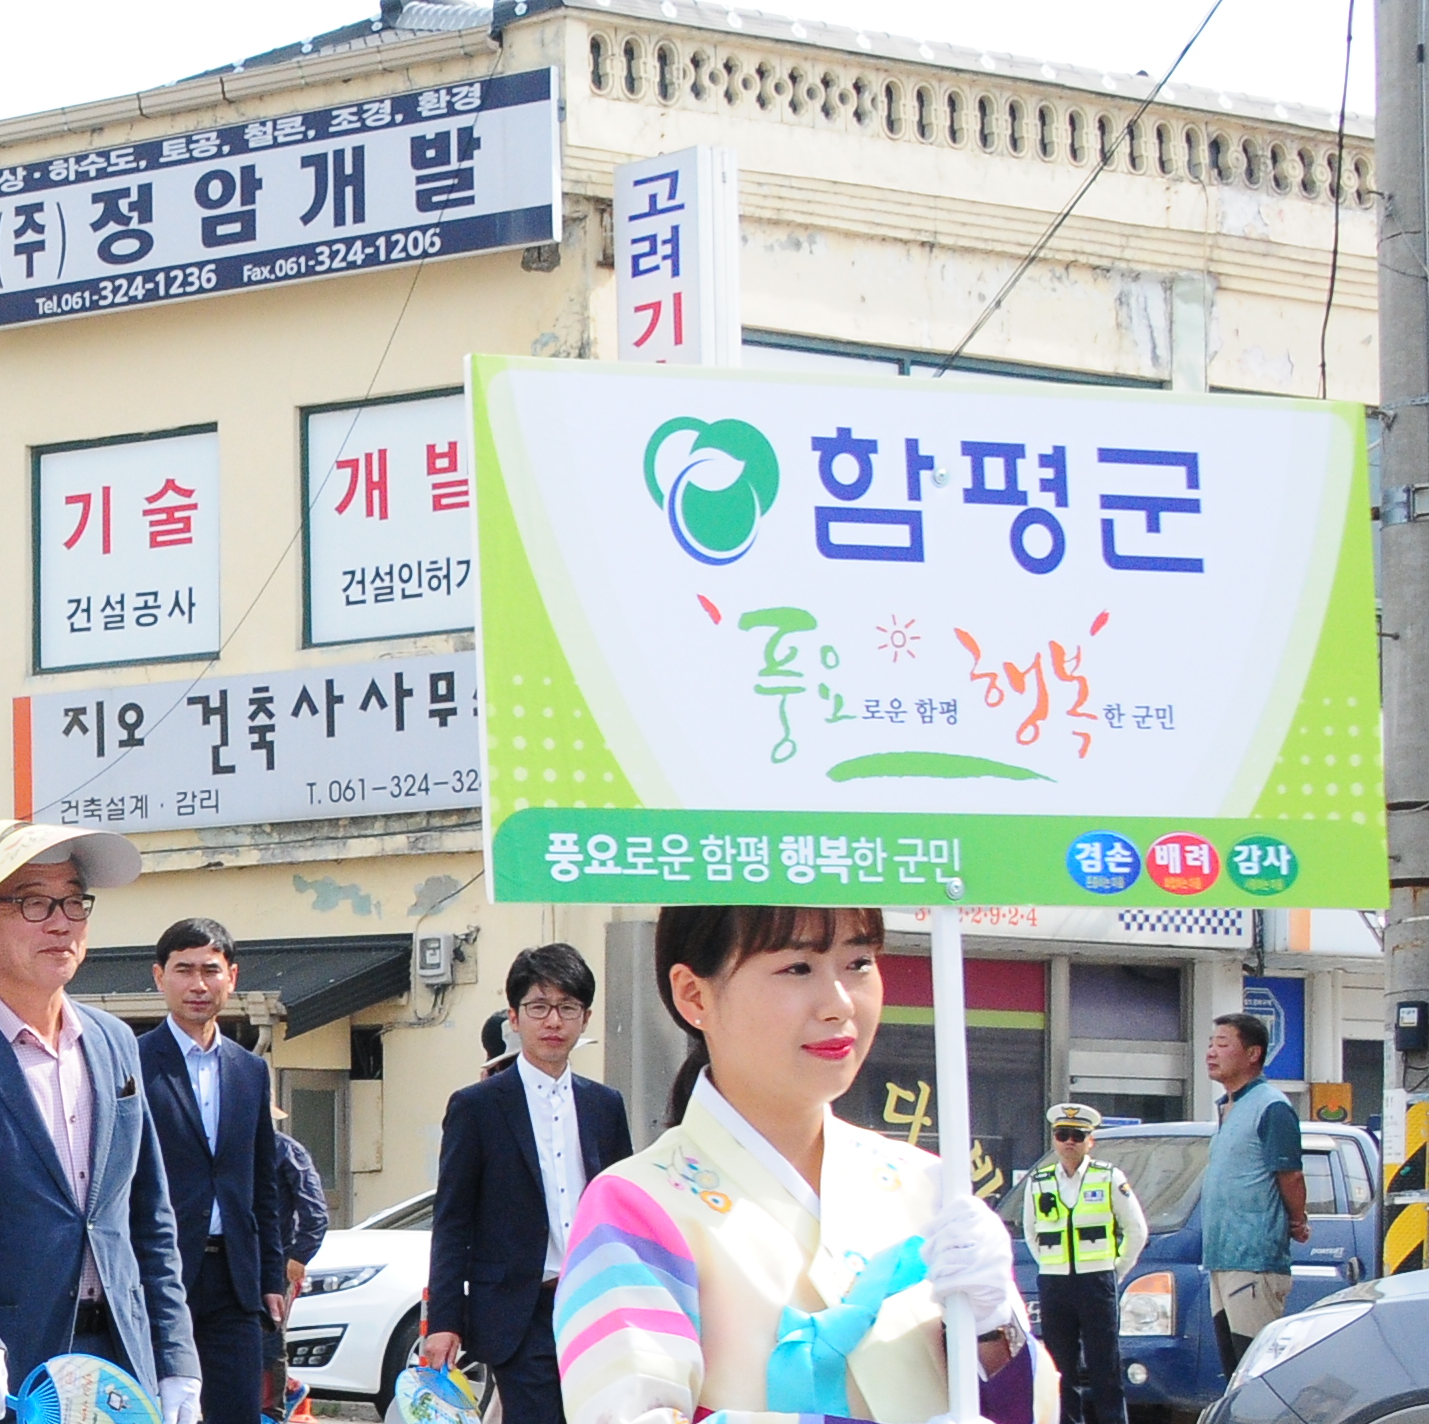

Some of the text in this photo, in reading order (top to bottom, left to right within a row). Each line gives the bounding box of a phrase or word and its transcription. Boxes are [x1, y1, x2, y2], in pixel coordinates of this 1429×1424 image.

[416, 84, 484, 119] 환경
[62, 478, 200, 555] 기술
[810, 426, 1206, 575] 함평군
[67, 587, 196, 633] 건설공사
[62, 670, 479, 776] 지오 건축사사무
[915, 697, 959, 727] 함평
[1132, 703, 1176, 730] 군민
[544, 832, 962, 884] 풍요로운 함평 행복한 군민
[1075, 842, 1133, 874] 겸손
[1154, 843, 1211, 874] 배려
[1233, 845, 1291, 875] 감사
